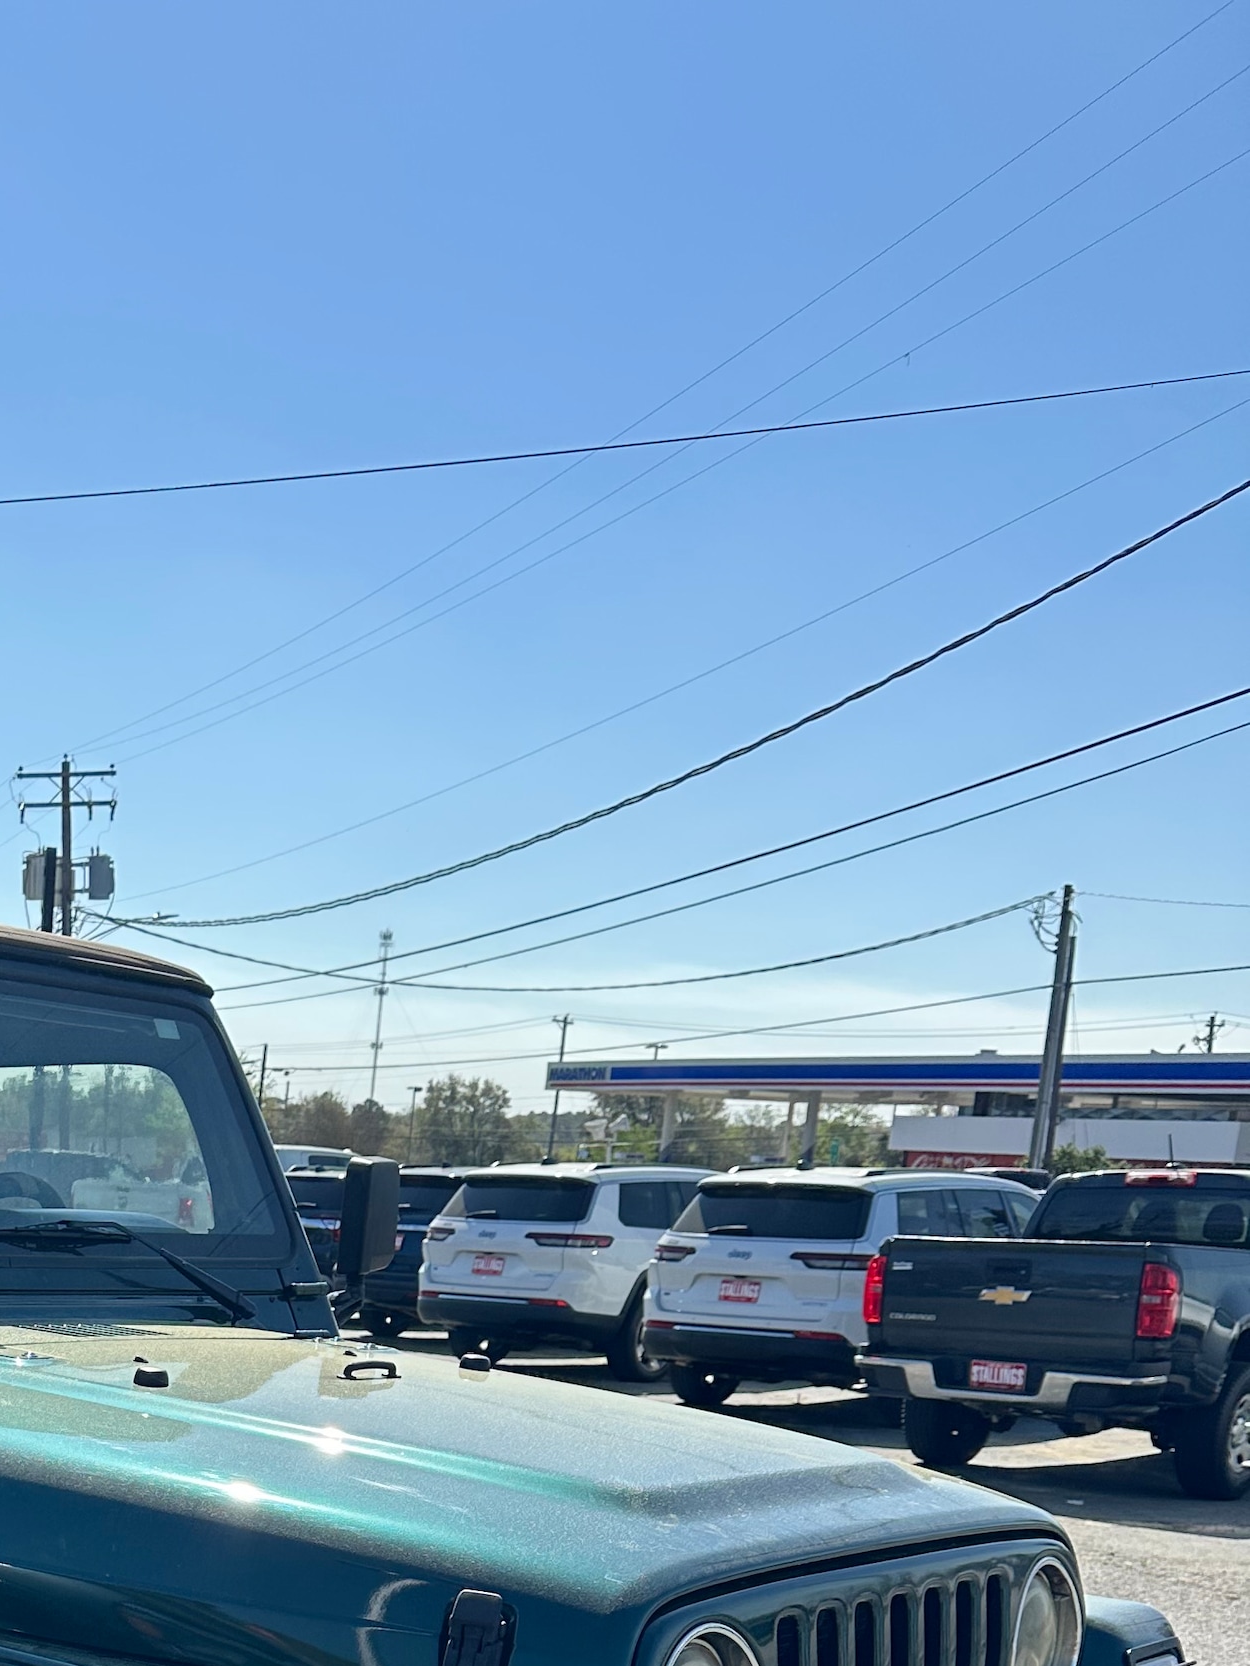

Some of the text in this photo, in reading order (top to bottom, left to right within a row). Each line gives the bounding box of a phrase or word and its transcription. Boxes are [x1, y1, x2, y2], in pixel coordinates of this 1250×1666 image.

[550, 1067, 607, 1081] MARATHON
[719, 1282, 760, 1299] STALLINGS
[971, 1365, 1024, 1385] STALLINGS
